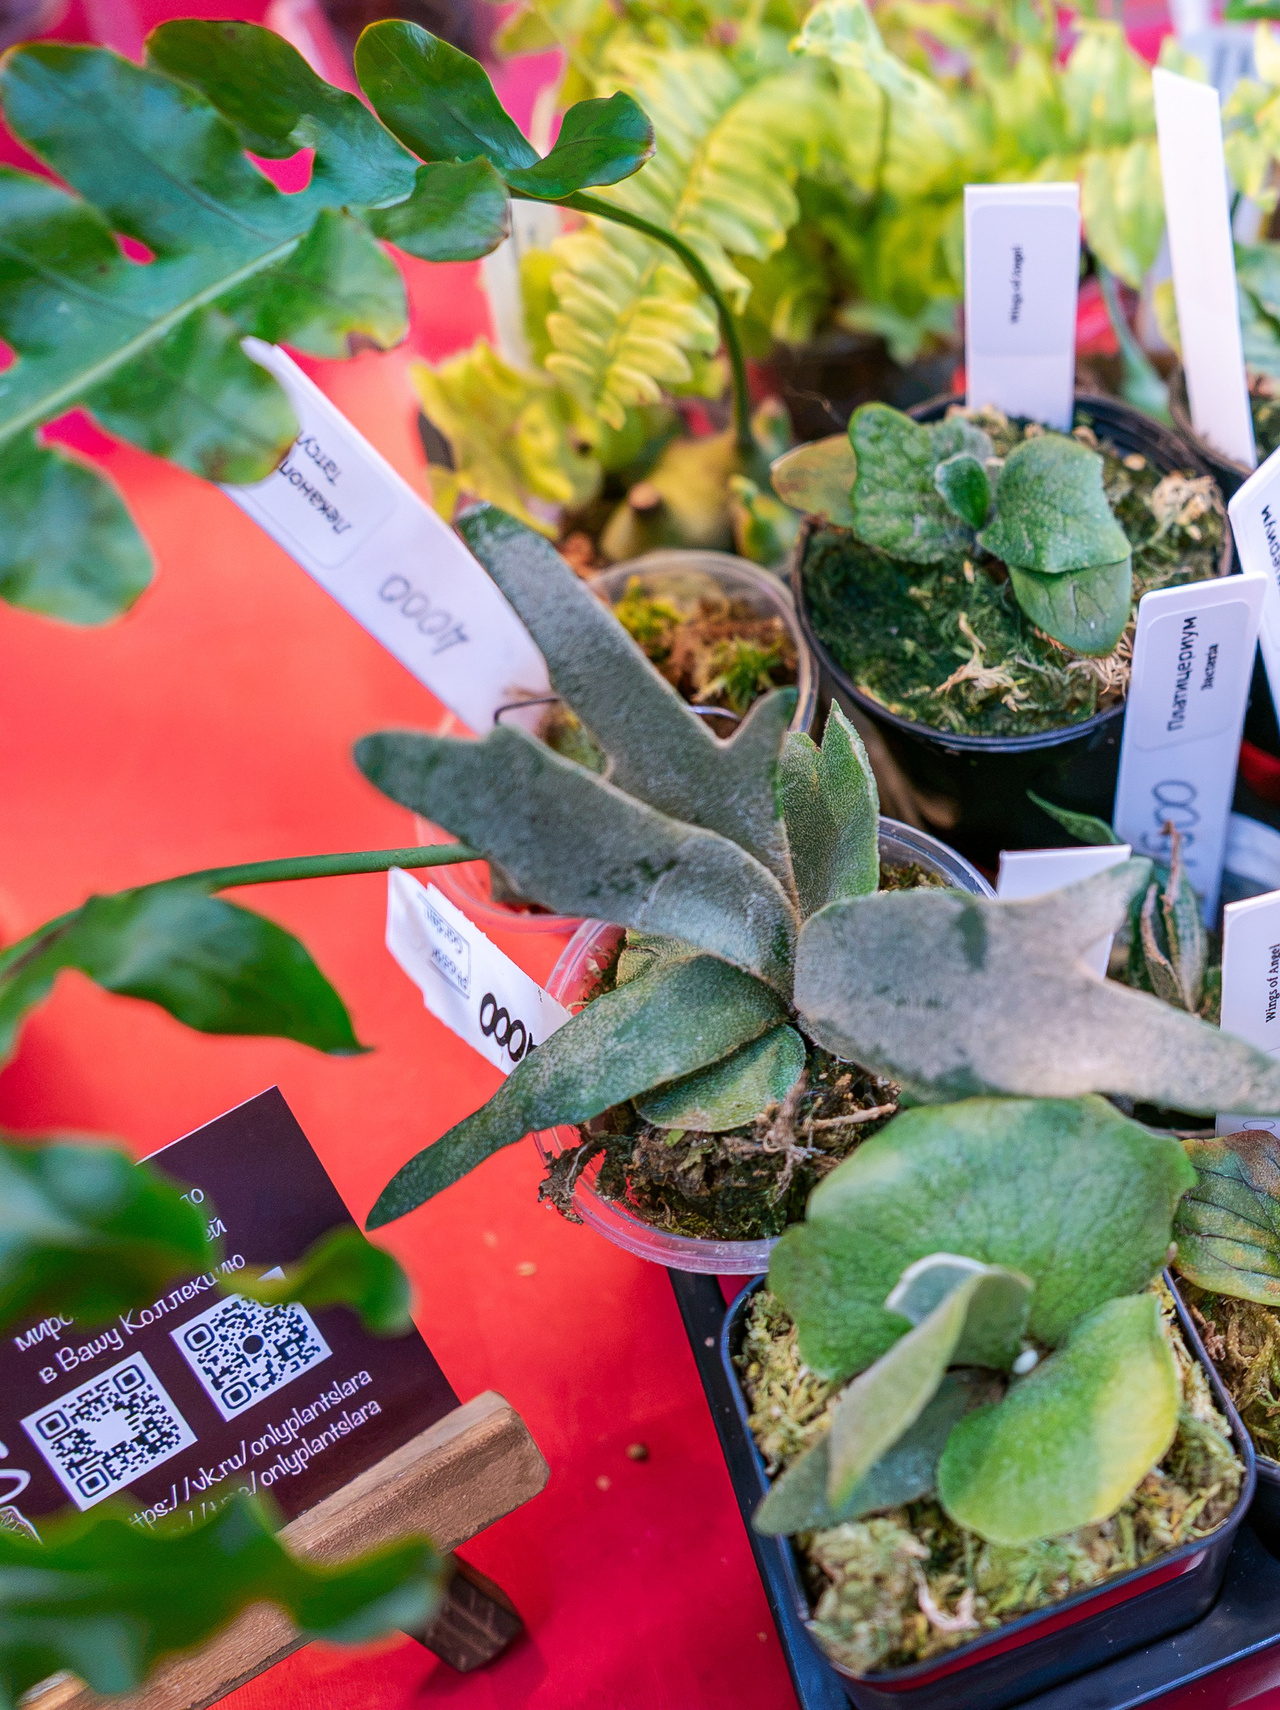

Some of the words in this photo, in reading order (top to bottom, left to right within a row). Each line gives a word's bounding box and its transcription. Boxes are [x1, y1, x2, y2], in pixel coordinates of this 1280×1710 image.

[278, 458, 353, 535] Леканоп
[377, 572, 471, 656] 4000
[1166, 615, 1199, 733] Платицериум
[1265, 987, 1280, 1023] Wings
[1268, 973, 1279, 988] of
[38, 1365, 59, 1385] в
[54, 1327, 125, 1373] Вашу
[129, 1370, 373, 1531] tps://vk.ru/onlyplantslara
